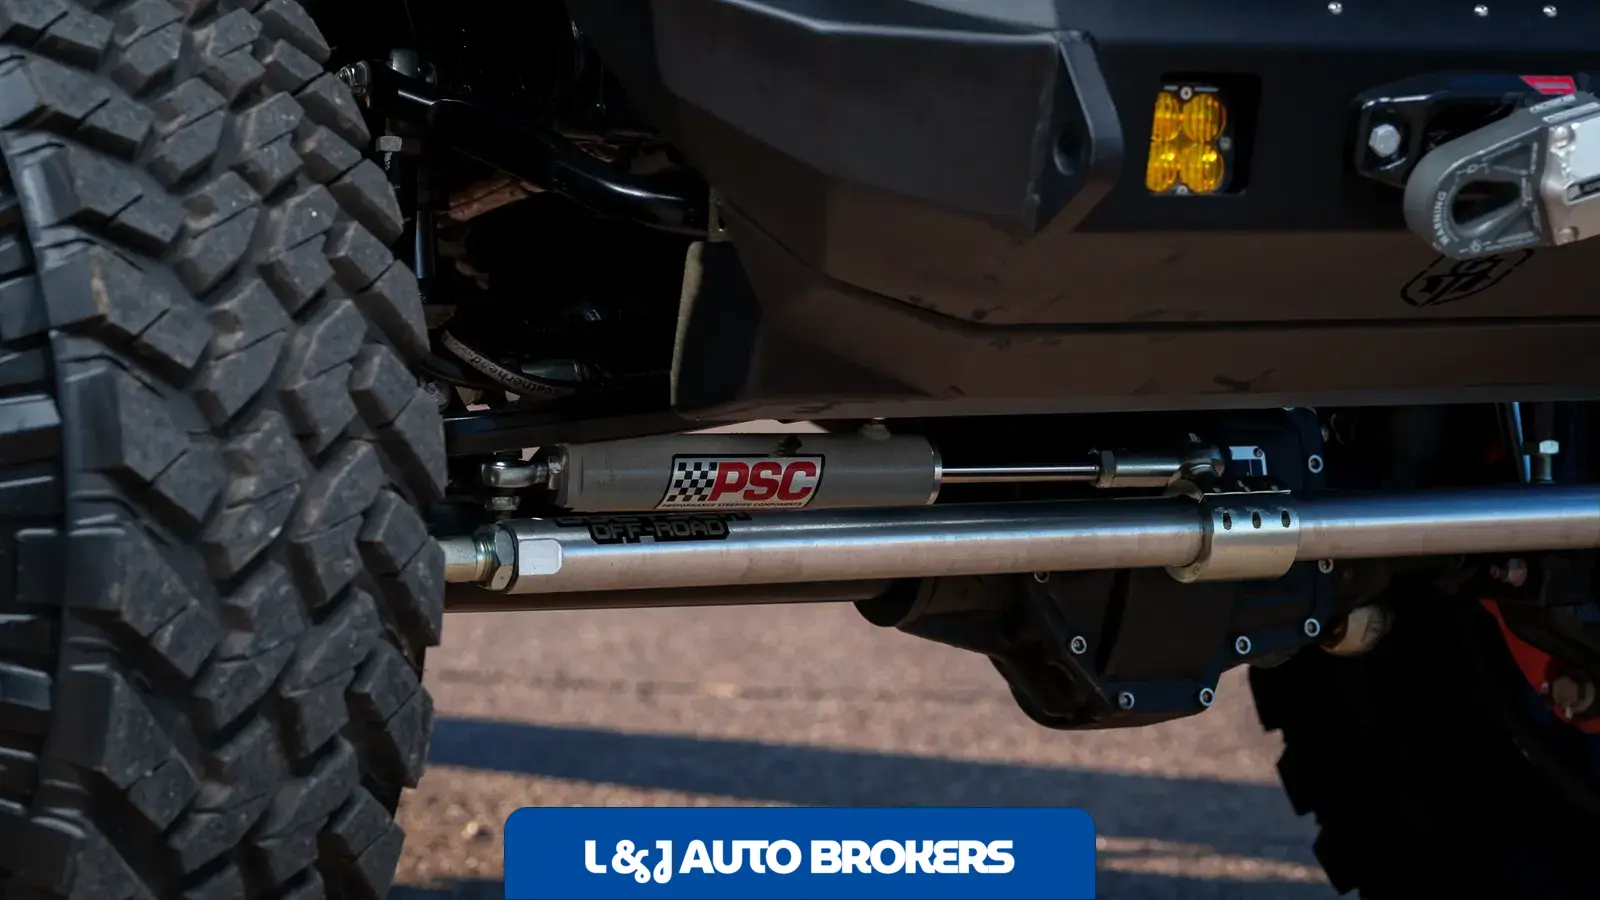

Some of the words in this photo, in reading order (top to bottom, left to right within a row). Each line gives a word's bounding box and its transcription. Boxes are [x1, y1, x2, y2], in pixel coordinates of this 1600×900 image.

[1432, 191, 1450, 246] WARNING
[707, 461, 817, 502] PSC
[594, 520, 726, 540] OFF-ROAD
